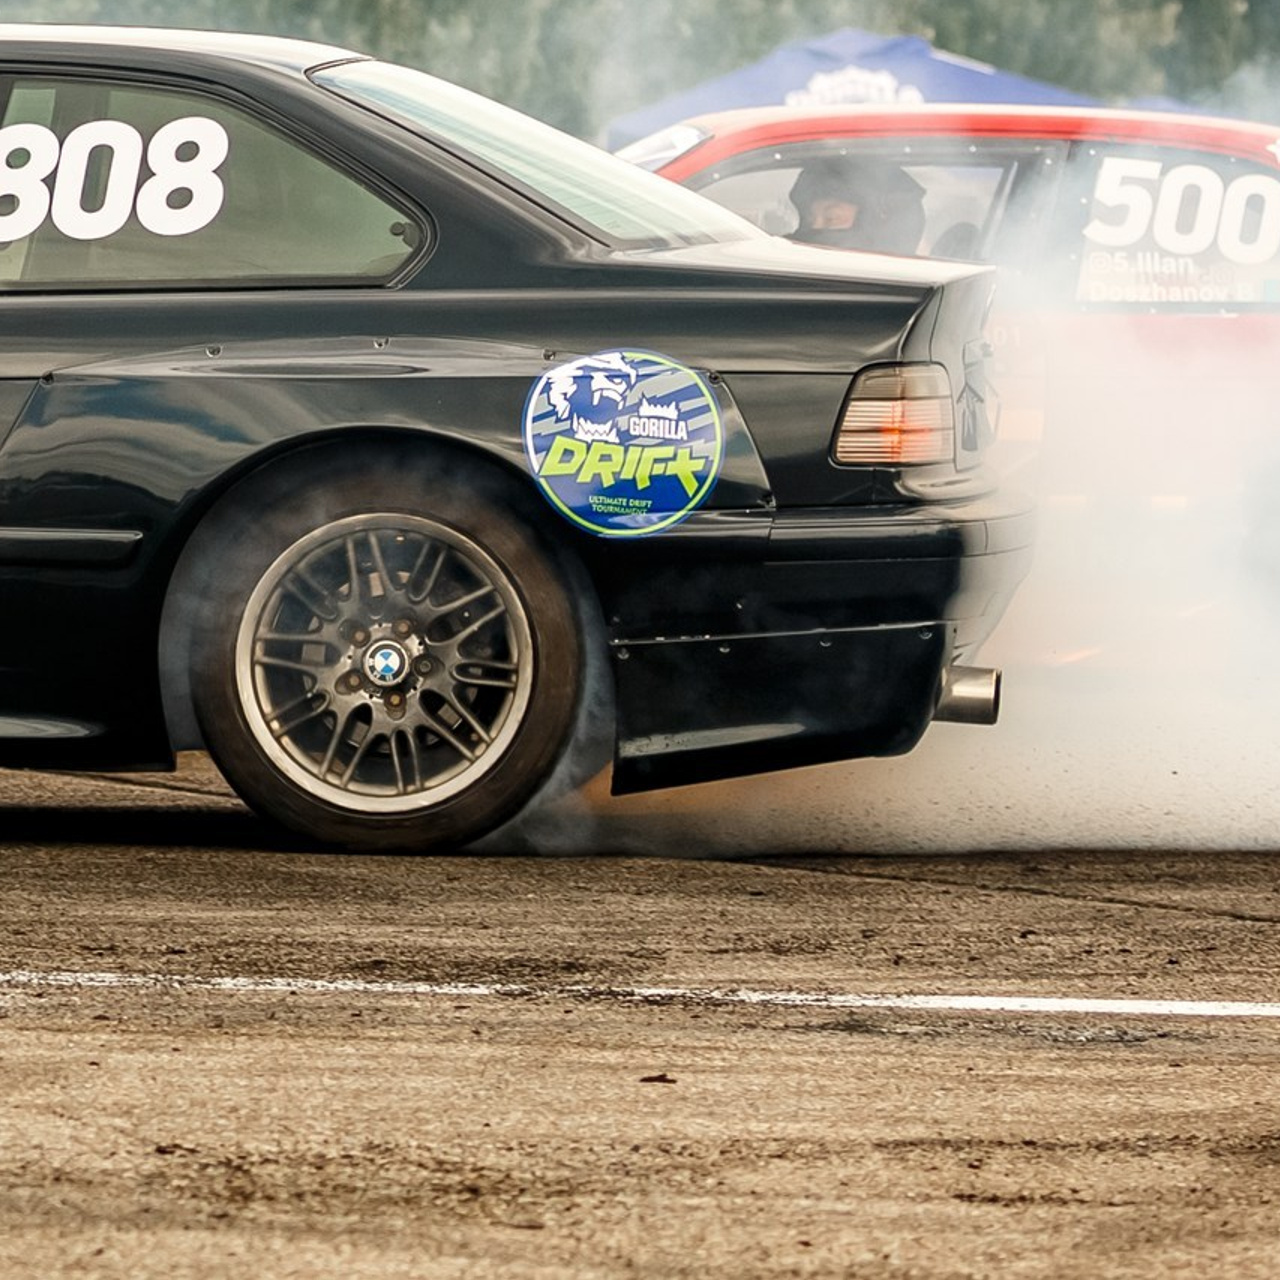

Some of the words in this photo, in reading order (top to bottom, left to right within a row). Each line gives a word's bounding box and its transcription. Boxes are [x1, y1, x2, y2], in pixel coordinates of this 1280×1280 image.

[1081, 156, 1280, 265] 500
[629, 417, 688, 440] GORILLA
[539, 435, 706, 498] DRIFT
[589, 495, 627, 506] ULTIMATE
[629, 498, 653, 508] DRIFT
[592, 504, 648, 516] TOURNAMENT
